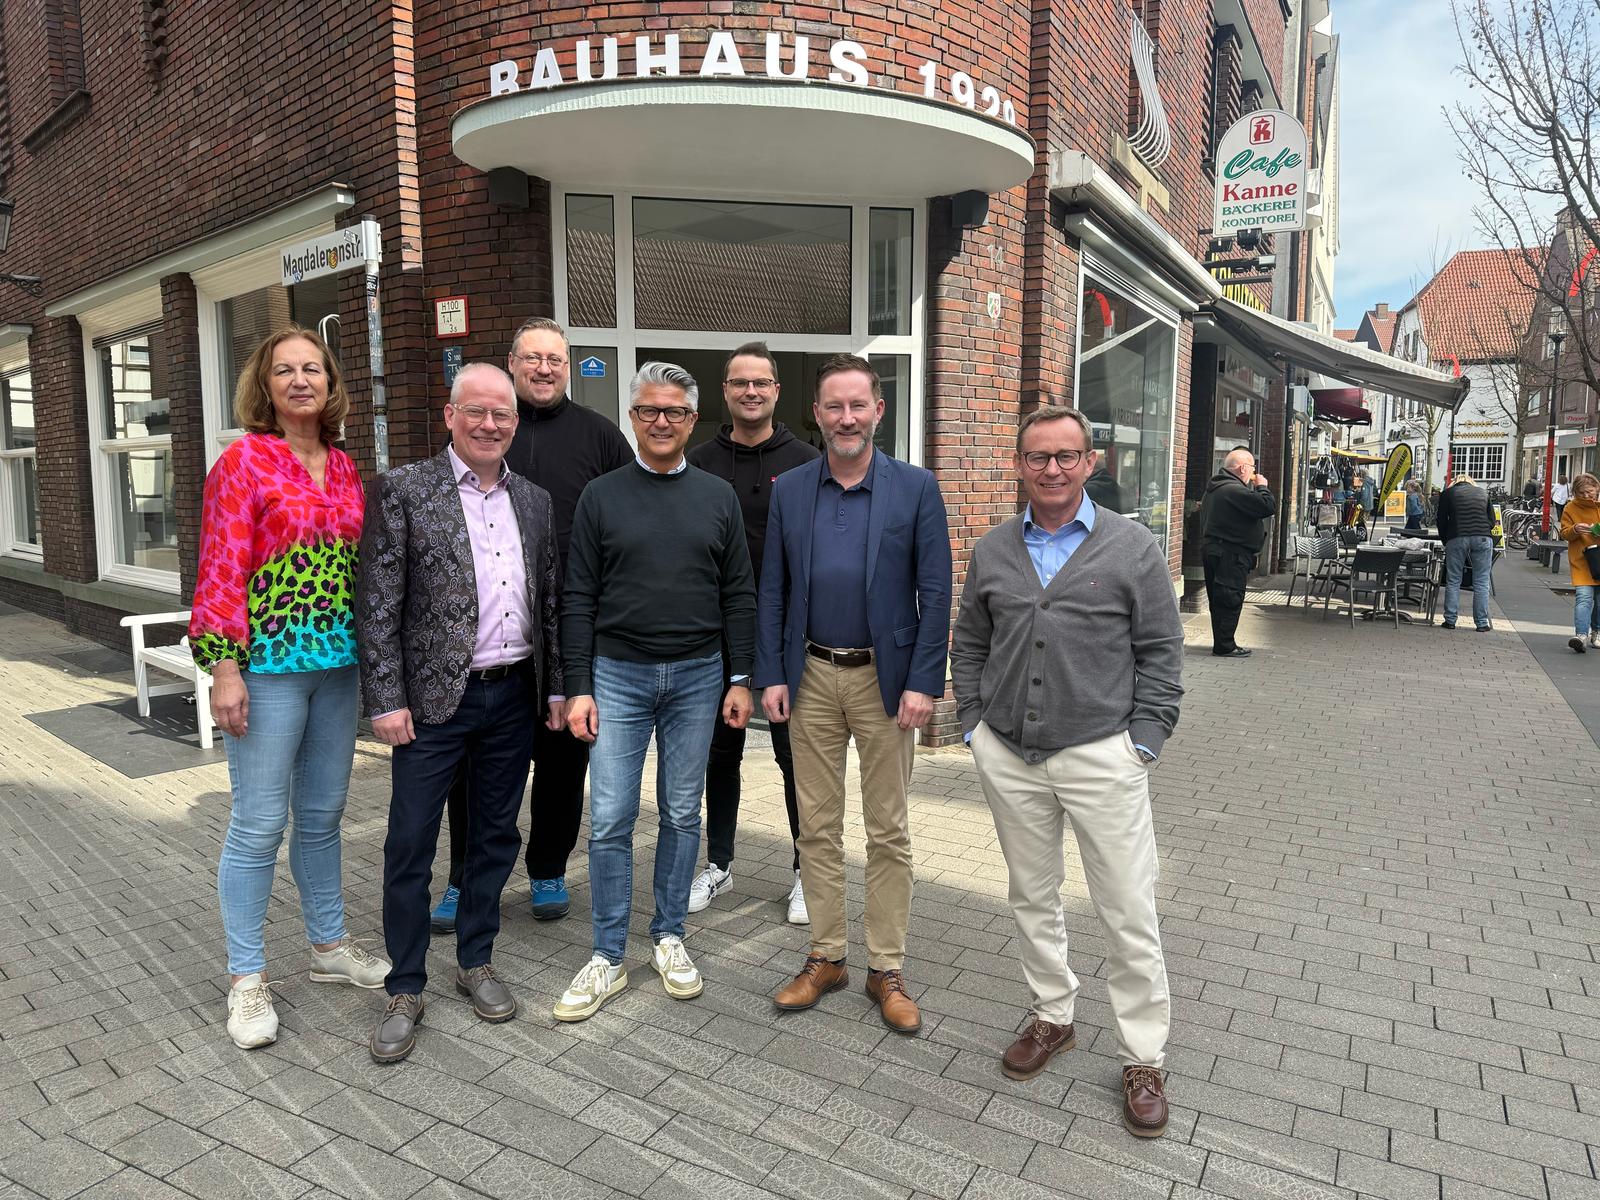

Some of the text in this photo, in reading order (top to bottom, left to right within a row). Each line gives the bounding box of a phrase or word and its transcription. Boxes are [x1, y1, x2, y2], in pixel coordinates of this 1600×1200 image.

[489, 31, 871, 97] BAUHAUS
[1222, 182, 1298, 202] Kanne
[1221, 213, 1296, 228] KONDITOREI
[282, 237, 364, 280] Magdalennstr.
[441, 300, 459, 311] H100
